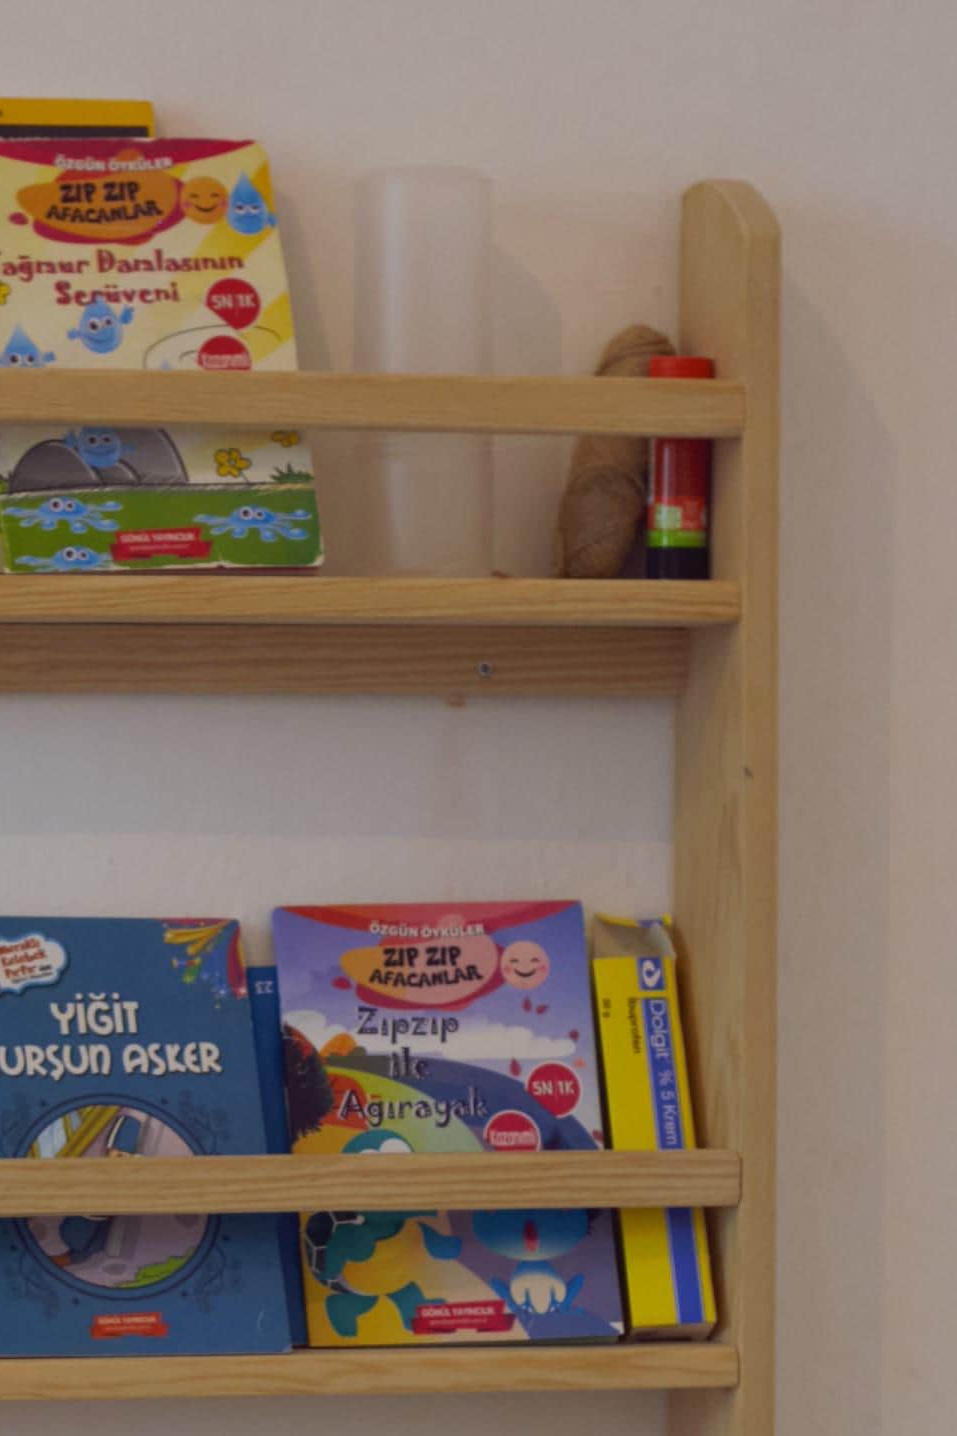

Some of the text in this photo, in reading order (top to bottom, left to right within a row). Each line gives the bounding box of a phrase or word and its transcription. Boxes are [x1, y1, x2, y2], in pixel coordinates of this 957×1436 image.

[54, 154, 106, 171] ÖZGÜN
[60, 181, 140, 203] ZIP ZIP
[45, 200, 162, 225] AFACANLAR
[97, 250, 245, 274] Damlasının
[54, 281, 180, 306] Serüveni
[369, 921, 419, 937] ÖZGÜN
[383, 946, 462, 968] ZIP ZIP
[368, 965, 484, 989] AFACANLAR
[50, 992, 139, 1035] YİĞİT
[122, 1041, 223, 1075] ASKER
[649, 999, 670, 1058] Dolgit
[663, 1105, 678, 1146] Krem
